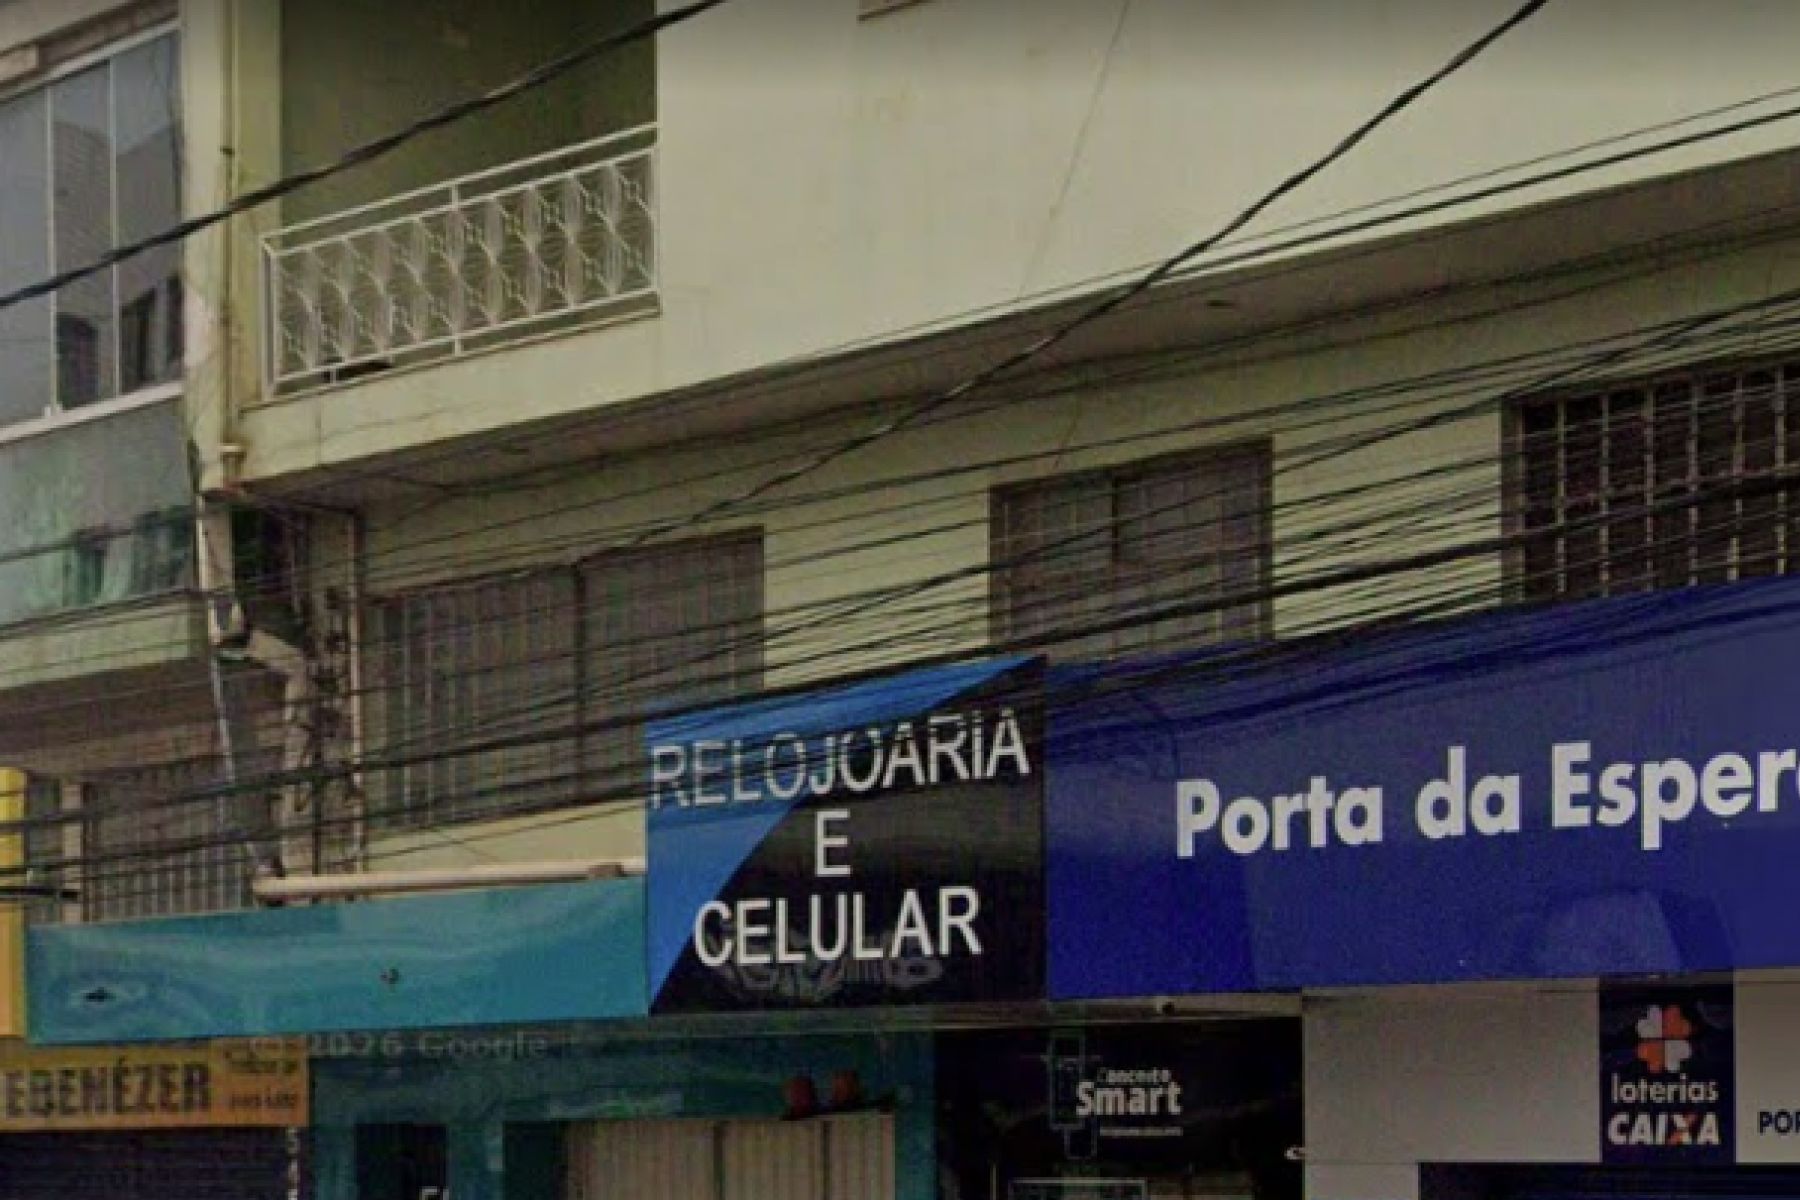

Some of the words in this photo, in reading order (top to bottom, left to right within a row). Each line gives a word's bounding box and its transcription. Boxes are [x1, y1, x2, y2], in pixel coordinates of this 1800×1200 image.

[650, 707, 1031, 809] RELOJOARIA
[1175, 778, 1384, 858] Porta
[1415, 745, 1521, 840] da
[814, 807, 852, 878] E
[693, 885, 983, 967] CELULAR
[1075, 1080, 1183, 1116] Smart
[1611, 1073, 1720, 1104] loterias
[1606, 1111, 1721, 1146] CAIXA
